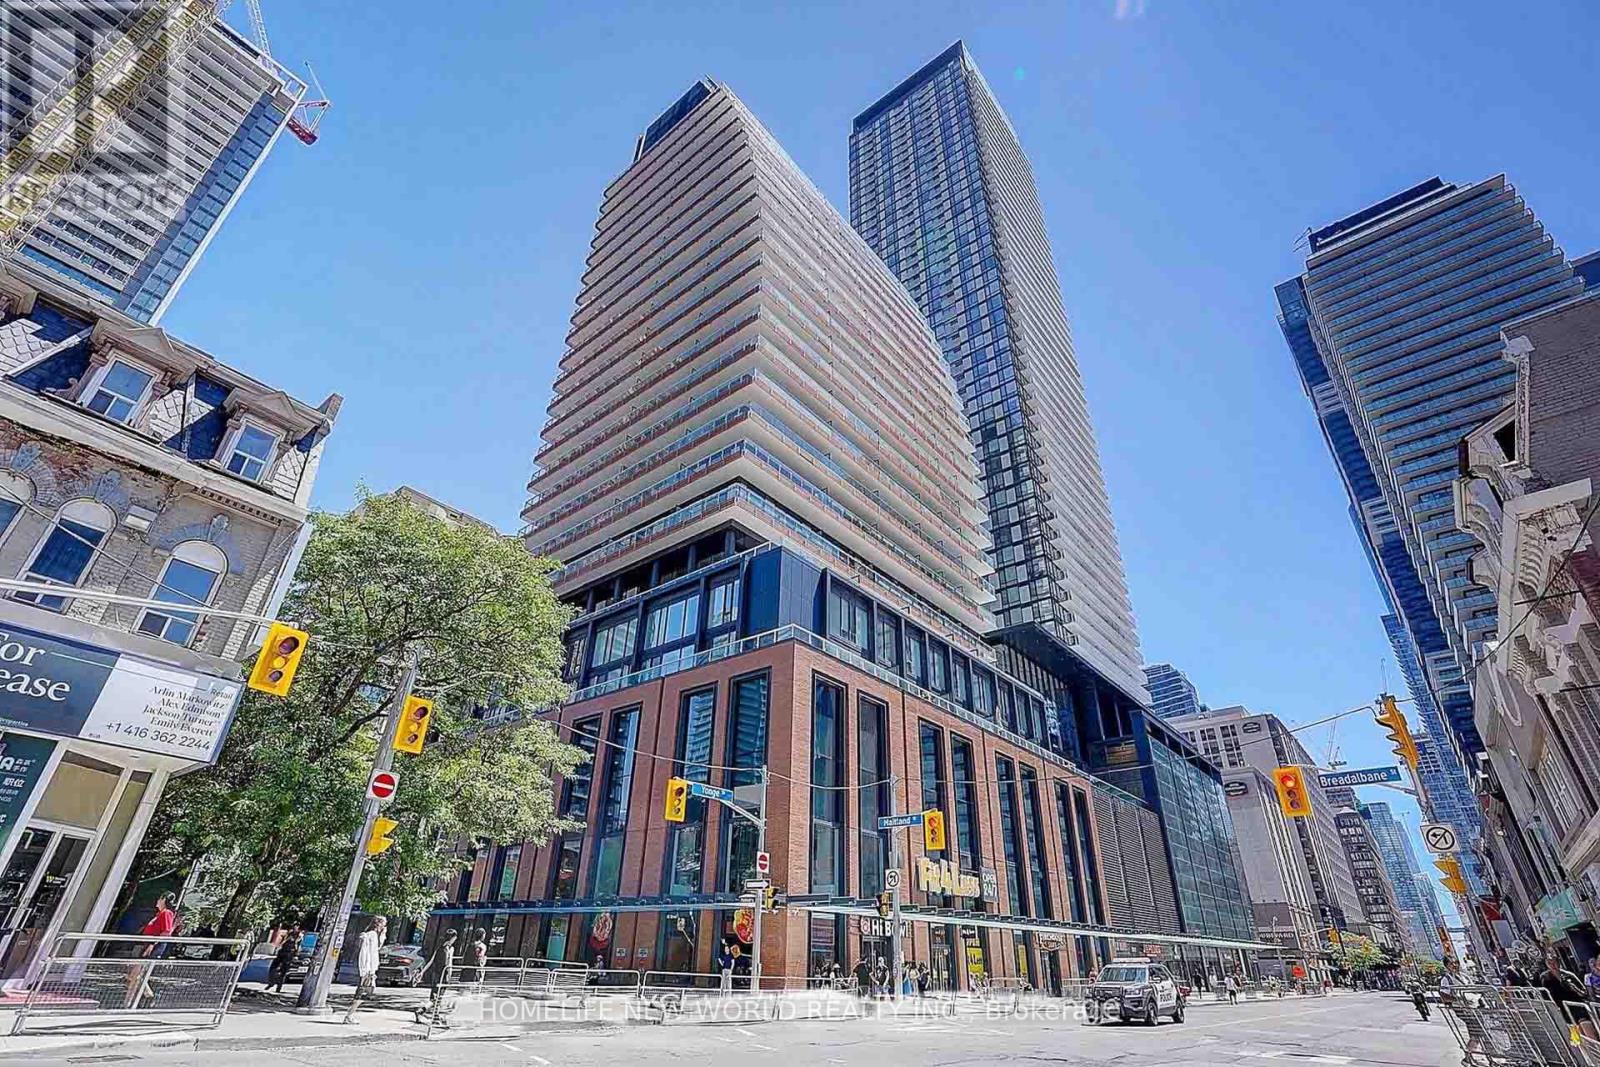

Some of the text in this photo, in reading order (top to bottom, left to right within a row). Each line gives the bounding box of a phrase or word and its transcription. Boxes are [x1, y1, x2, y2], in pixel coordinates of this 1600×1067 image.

[160, 699, 179, 710] Alex
[142, 704, 214, 727] Jackson Turner
[150, 717, 178, 731] Emily
[105, 722, 210, 751] +1 416 362 2244
[1320, 771, 1388, 787] Breadalbane
[701, 786, 720, 798] Yonge
[883, 816, 911, 827] Maitland
